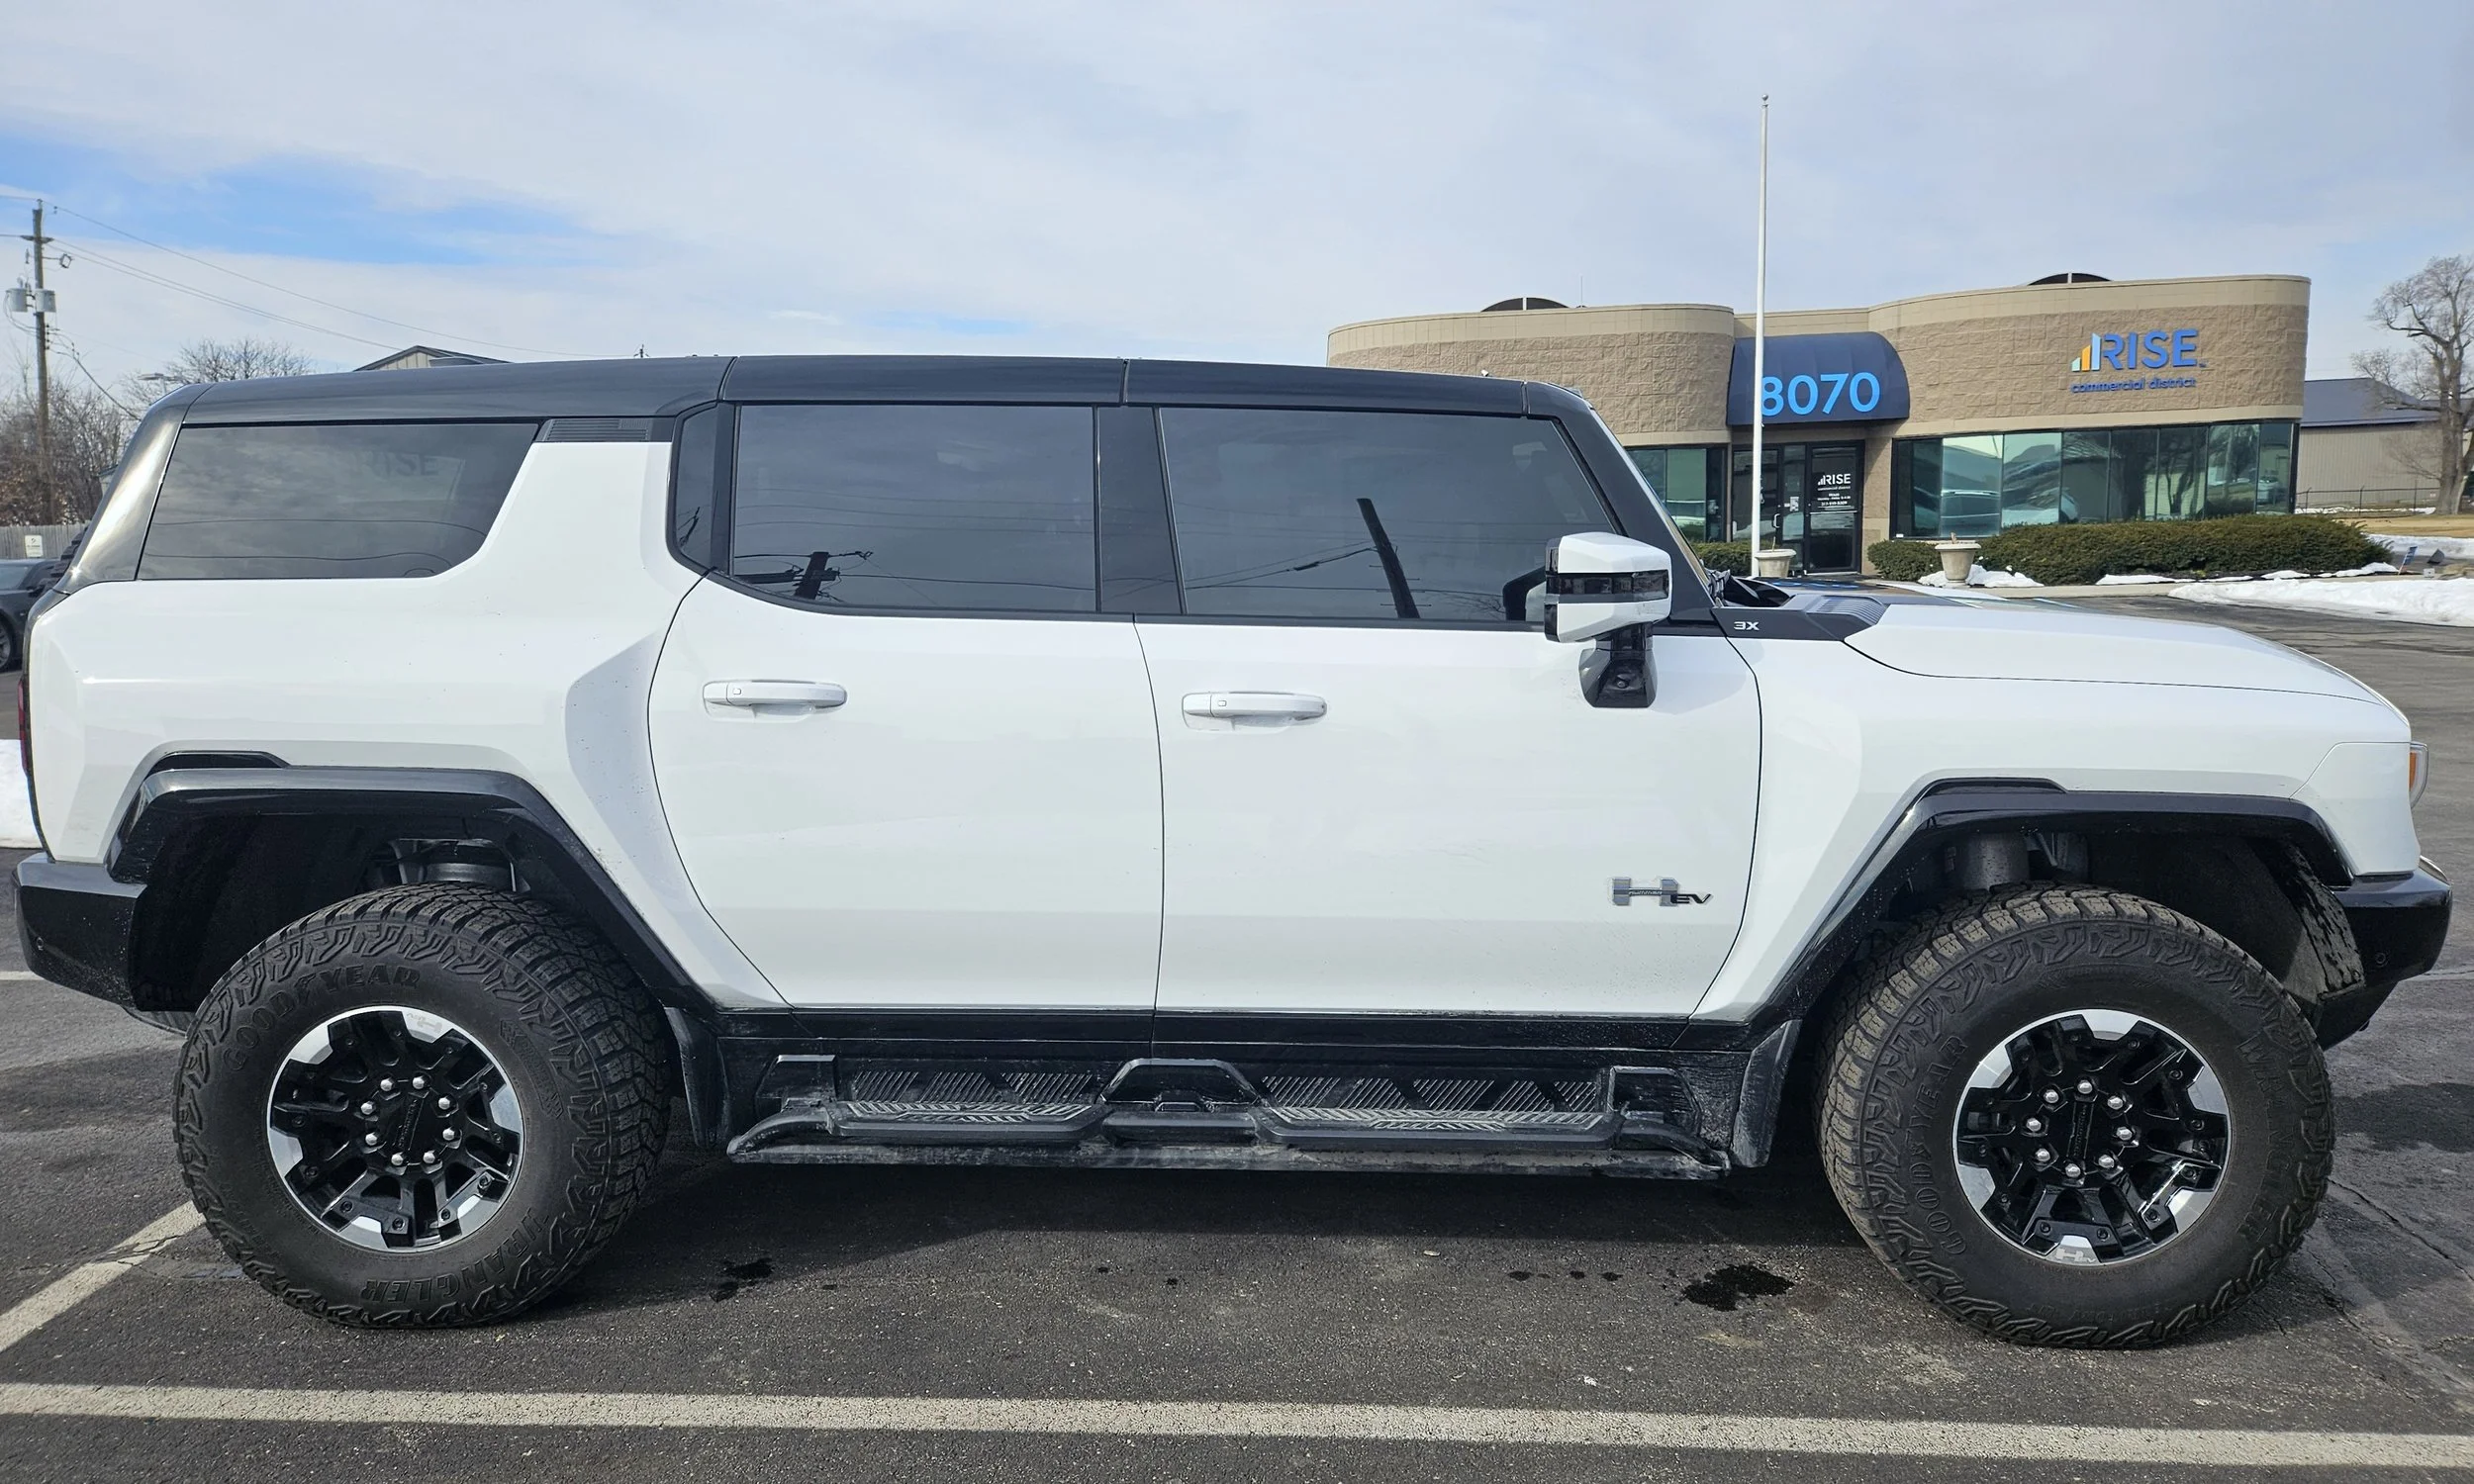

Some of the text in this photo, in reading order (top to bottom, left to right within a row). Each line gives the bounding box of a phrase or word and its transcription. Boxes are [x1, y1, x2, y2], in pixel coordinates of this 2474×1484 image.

[2091, 328, 2199, 371] RISE
[2071, 377, 2196, 393] commercial district
[1761, 372, 1880, 417] 8070
[1822, 473, 1852, 485] RISE
[1734, 621, 1760, 630] 3X
